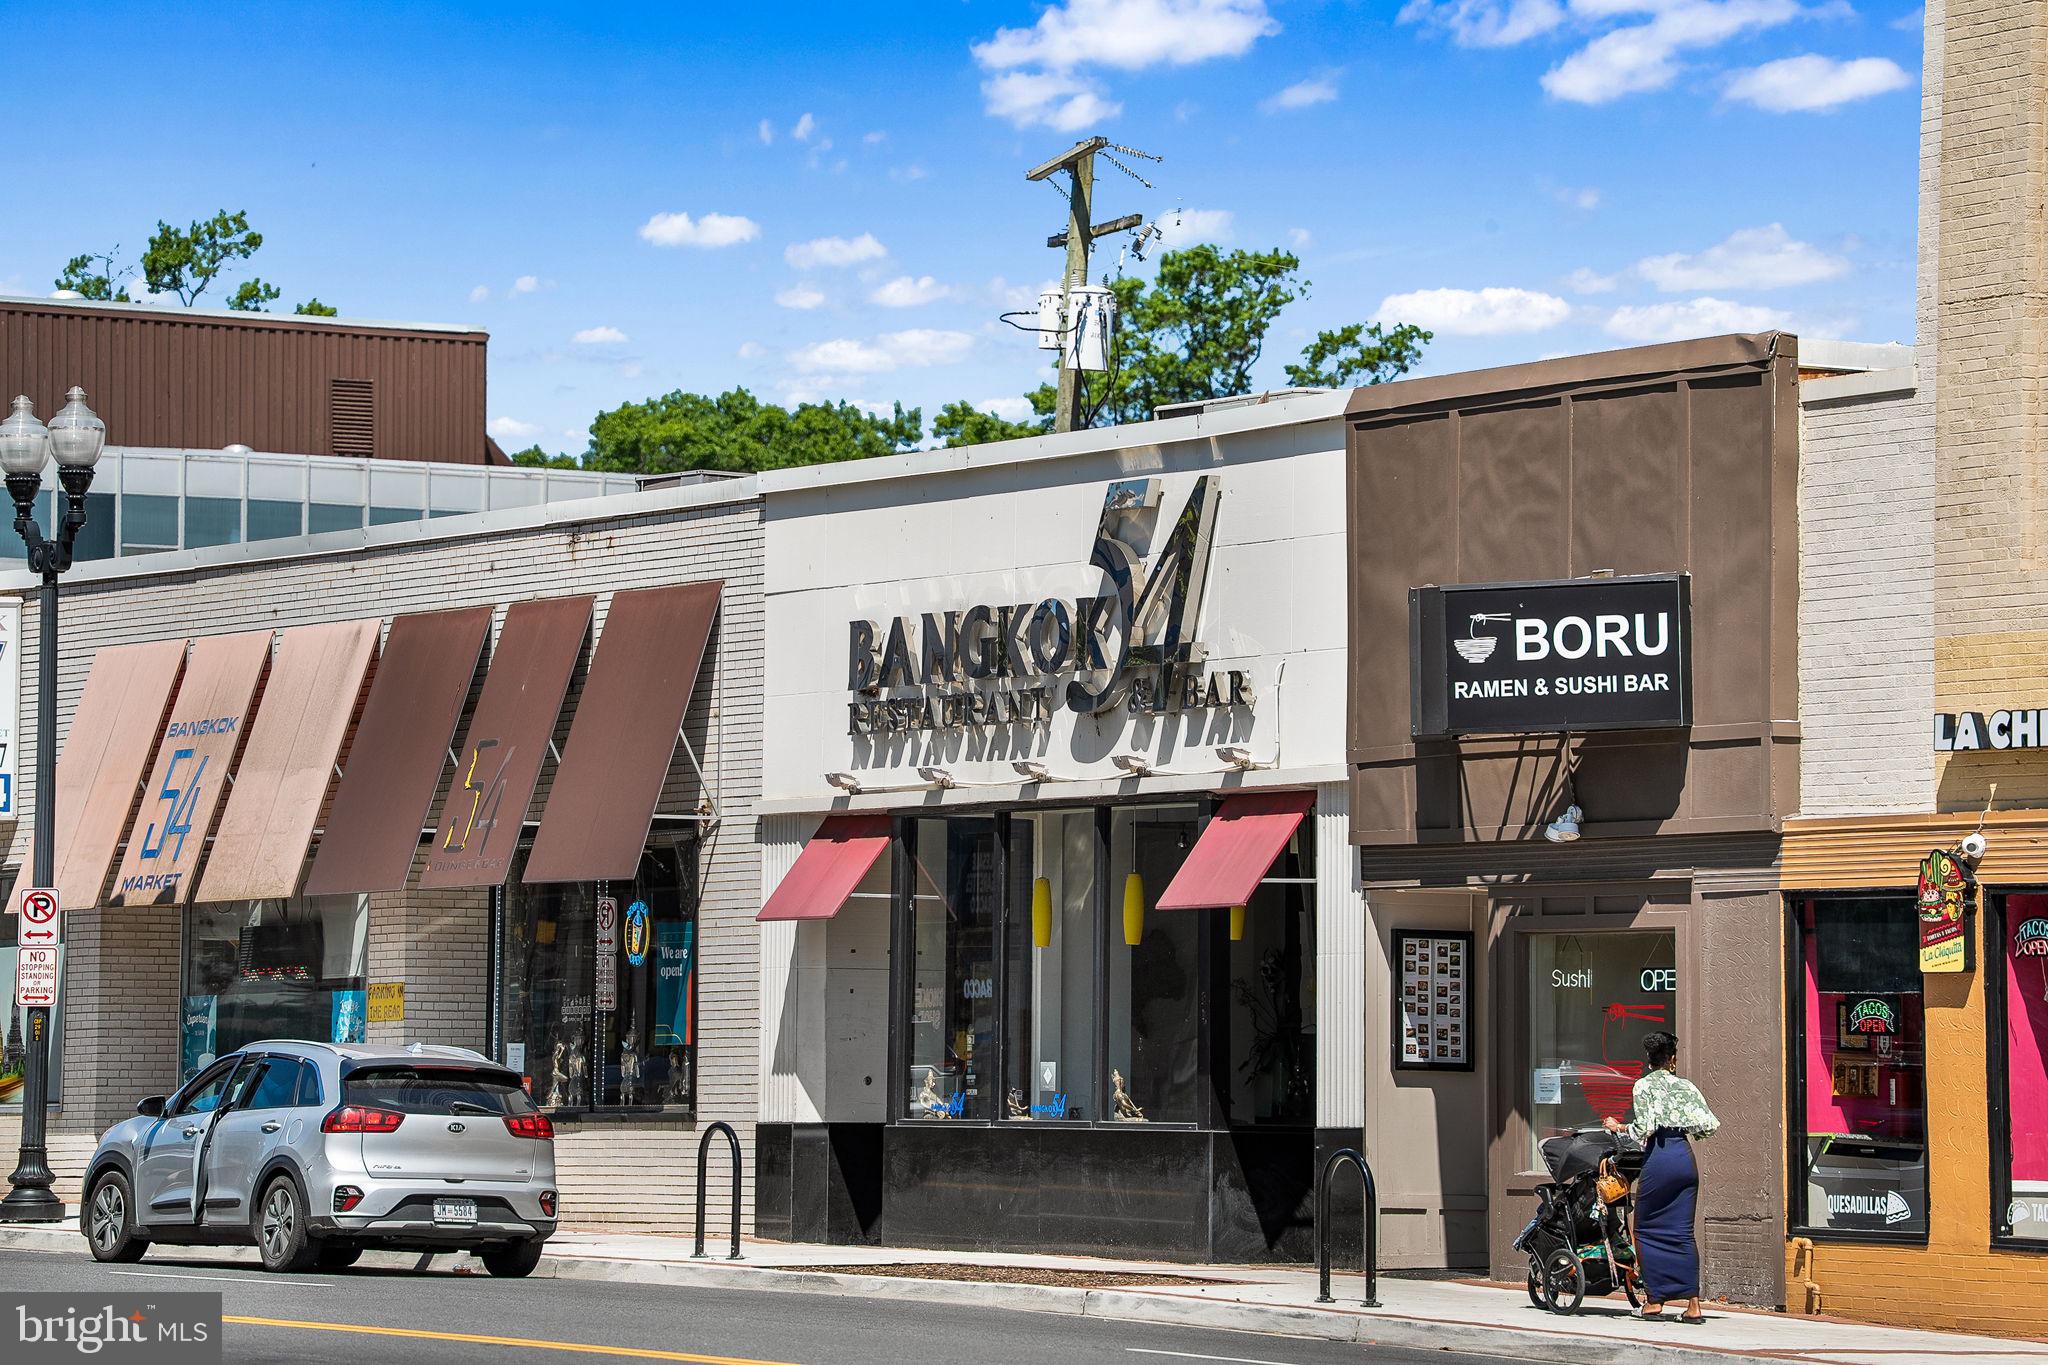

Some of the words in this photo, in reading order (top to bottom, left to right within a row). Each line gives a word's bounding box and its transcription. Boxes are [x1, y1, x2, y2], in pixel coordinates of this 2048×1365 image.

[1067, 475, 1220, 712] 54
[848, 595, 1119, 691] BANGKOK
[1516, 611, 1669, 661] BORU
[1454, 679, 1528, 699] RAMEN
[1534, 678, 1549, 695] &
[1555, 675, 1617, 694] SUSHI
[1624, 673, 1669, 692] BAR
[847, 686, 1057, 736] RESTAURANT
[1128, 677, 1152, 713] &
[1183, 670, 1252, 708] BAR
[167, 716, 239, 738] BANGKOK
[1934, 711, 1988, 751] LA
[140, 748, 209, 863] 54
[443, 738, 517, 857] 54
[122, 873, 182, 893] MARKET
[30, 951, 46, 962] NO
[661, 946, 674, 959] We
[675, 949, 688, 959] are
[21, 963, 54, 971] STOPPING
[21, 972, 54, 980] STANDING
[660, 963, 683, 979] open!
[20, 986, 53, 994] PARKING
[1856, 1001, 1889, 1019] TACOS
[1860, 1019, 1885, 1032] OPEN
[1053, 1093, 1068, 1118] 54
[1828, 1194, 1887, 1215] QUESADILLAS
